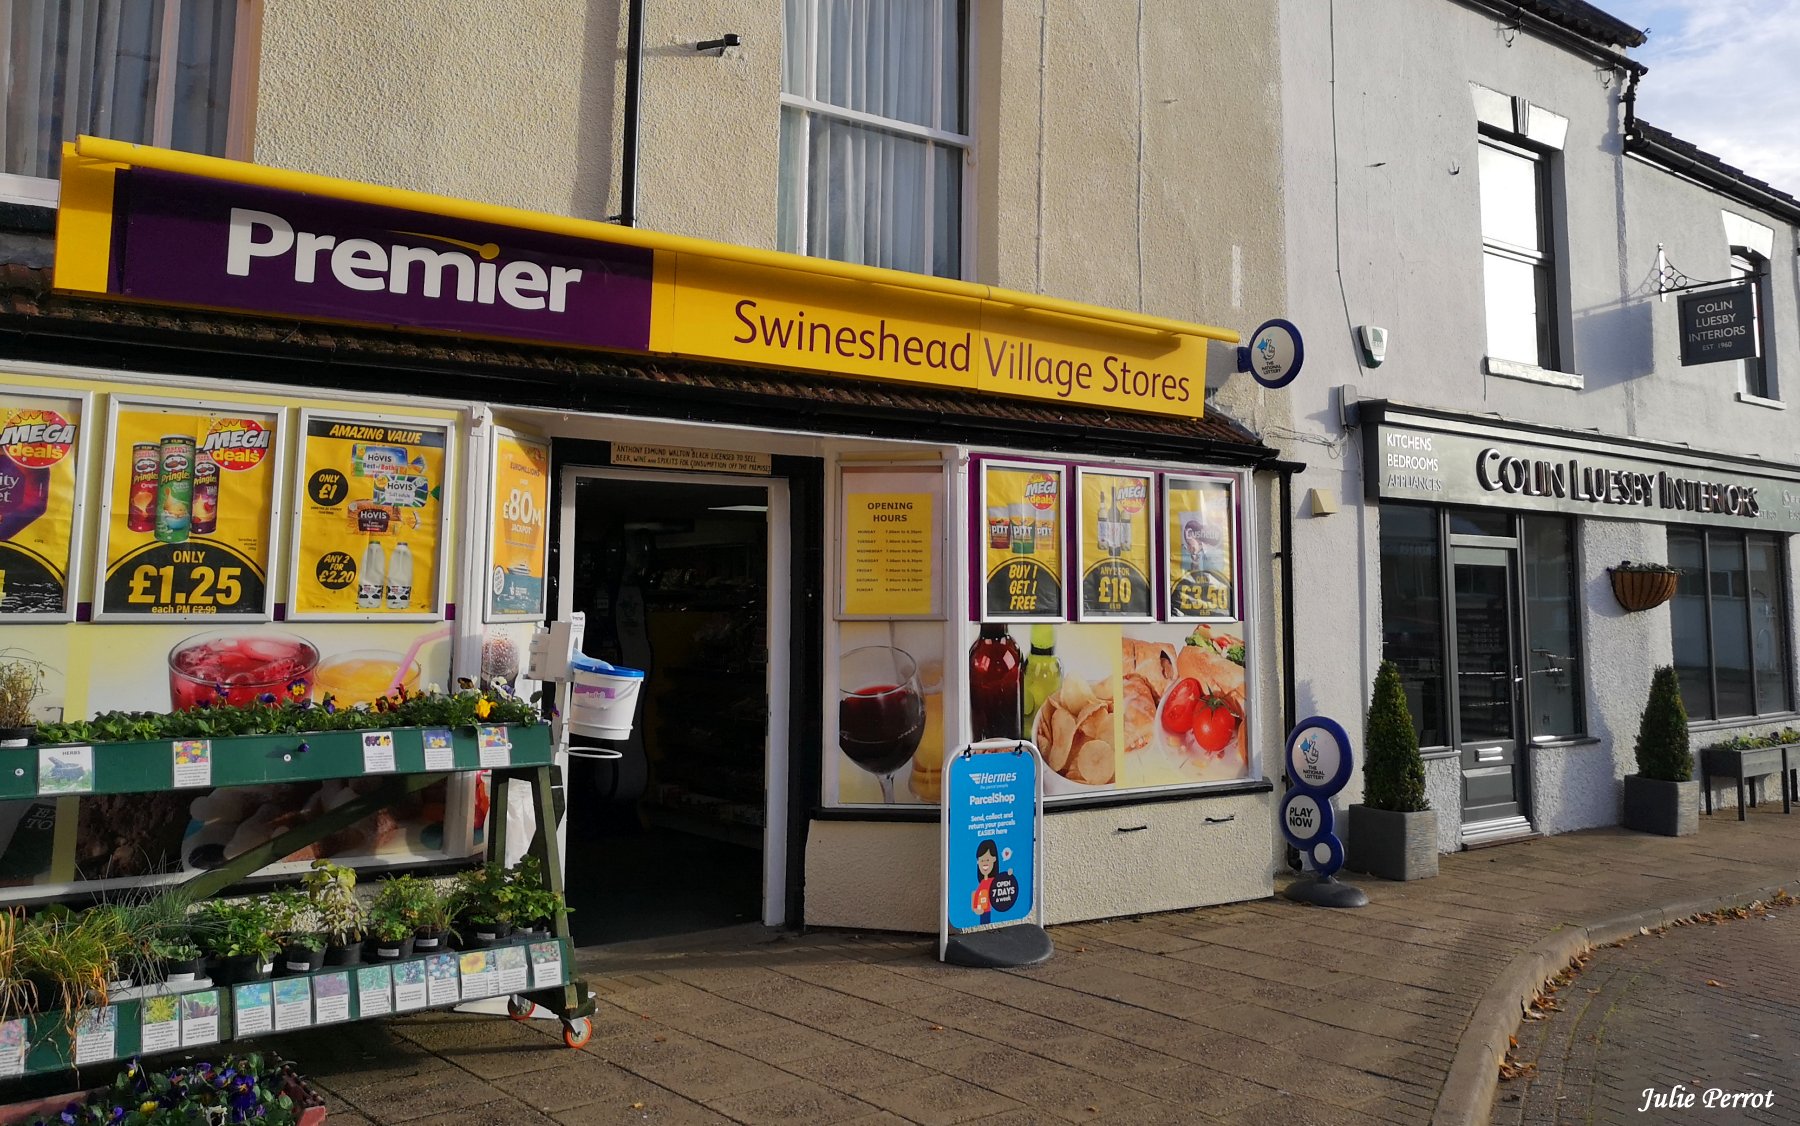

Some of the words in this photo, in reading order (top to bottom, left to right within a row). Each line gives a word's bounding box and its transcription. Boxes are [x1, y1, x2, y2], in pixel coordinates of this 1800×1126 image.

[227, 207, 583, 313] Premier
[1697, 300, 1733, 314] COLIN
[1695, 313, 1737, 328] LUESBY
[1688, 325, 1746, 342] INTERIORS
[733, 299, 971, 372] Swineshead
[983, 337, 1093, 397] Village
[1103, 355, 1190, 402] Stores
[1702, 343, 1714, 351] EST
[1718, 341, 1733, 349] 1960
[0, 424, 76, 446] MEGA
[203, 429, 271, 451] MEGA
[329, 424, 385, 440] AMAZING
[387, 429, 423, 444] VALUE
[1386, 433, 1432, 452] KITCHENS
[8, 443, 64, 460] deals
[211, 449, 260, 463] deals
[617, 445, 643, 454] ANTHONY
[644, 446, 666, 456] EDMUND
[669, 448, 690, 457] WALTON
[711, 452, 735, 461] LICENSED
[744, 454, 757, 463] SELL
[381, 463, 397, 471] Both
[633, 455, 646, 463] WINE
[657, 456, 678, 465] SPIRITS
[679, 458, 689, 466] FOR
[690, 459, 727, 469] CONSUMPTION
[1386, 453, 1439, 472] BEDROOMS
[161, 469, 191, 485] Pringles
[318, 474, 340, 484] ONLY
[1386, 473, 1442, 492] APPLIANCES
[1476, 447, 1566, 498] COLIN
[1569, 459, 1657, 507] LUESBY
[1659, 470, 1760, 518] INTERIORS
[318, 483, 337, 500] £1
[1024, 480, 1058, 498] MEGA
[1117, 484, 1146, 501] MEGA
[867, 502, 913, 510] OPENING
[1029, 494, 1055, 505] deals
[873, 514, 908, 522] HOURS
[173, 550, 206, 564] ONLY
[324, 554, 342, 564] ANY
[343, 555, 350, 564] 2
[329, 563, 344, 571] FOR
[1008, 564, 1030, 579] BUY
[1100, 567, 1113, 575] ANY
[1118, 567, 1130, 576] FOR
[319, 570, 355, 583] £2.20
[128, 564, 242, 605] £1.25
[1009, 580, 1030, 594] GET
[1098, 576, 1132, 603] £10
[1009, 595, 1037, 610] FREE
[1180, 585, 1228, 610] £3.50
[151, 605, 175, 614] each
[176, 605, 190, 614] PM
[192, 605, 217, 614] £2.99
[981, 772, 1017, 784] Hermes
[969, 792, 1016, 806] ParcelShop
[970, 813, 985, 823] Send,
[985, 812, 1002, 821] collect
[1003, 811, 1014, 819] and
[1289, 807, 1314, 818] PLAY
[968, 822, 984, 831] return
[985, 822, 997, 830] your
[997, 819, 1016, 829] parcels
[1289, 817, 1313, 828] NOW
[977, 828, 995, 837] EASIER
[996, 826, 1008, 835] here
[996, 880, 1011, 888] OPEN
[992, 888, 997, 898] 7
[997, 886, 1015, 896] DAYS
